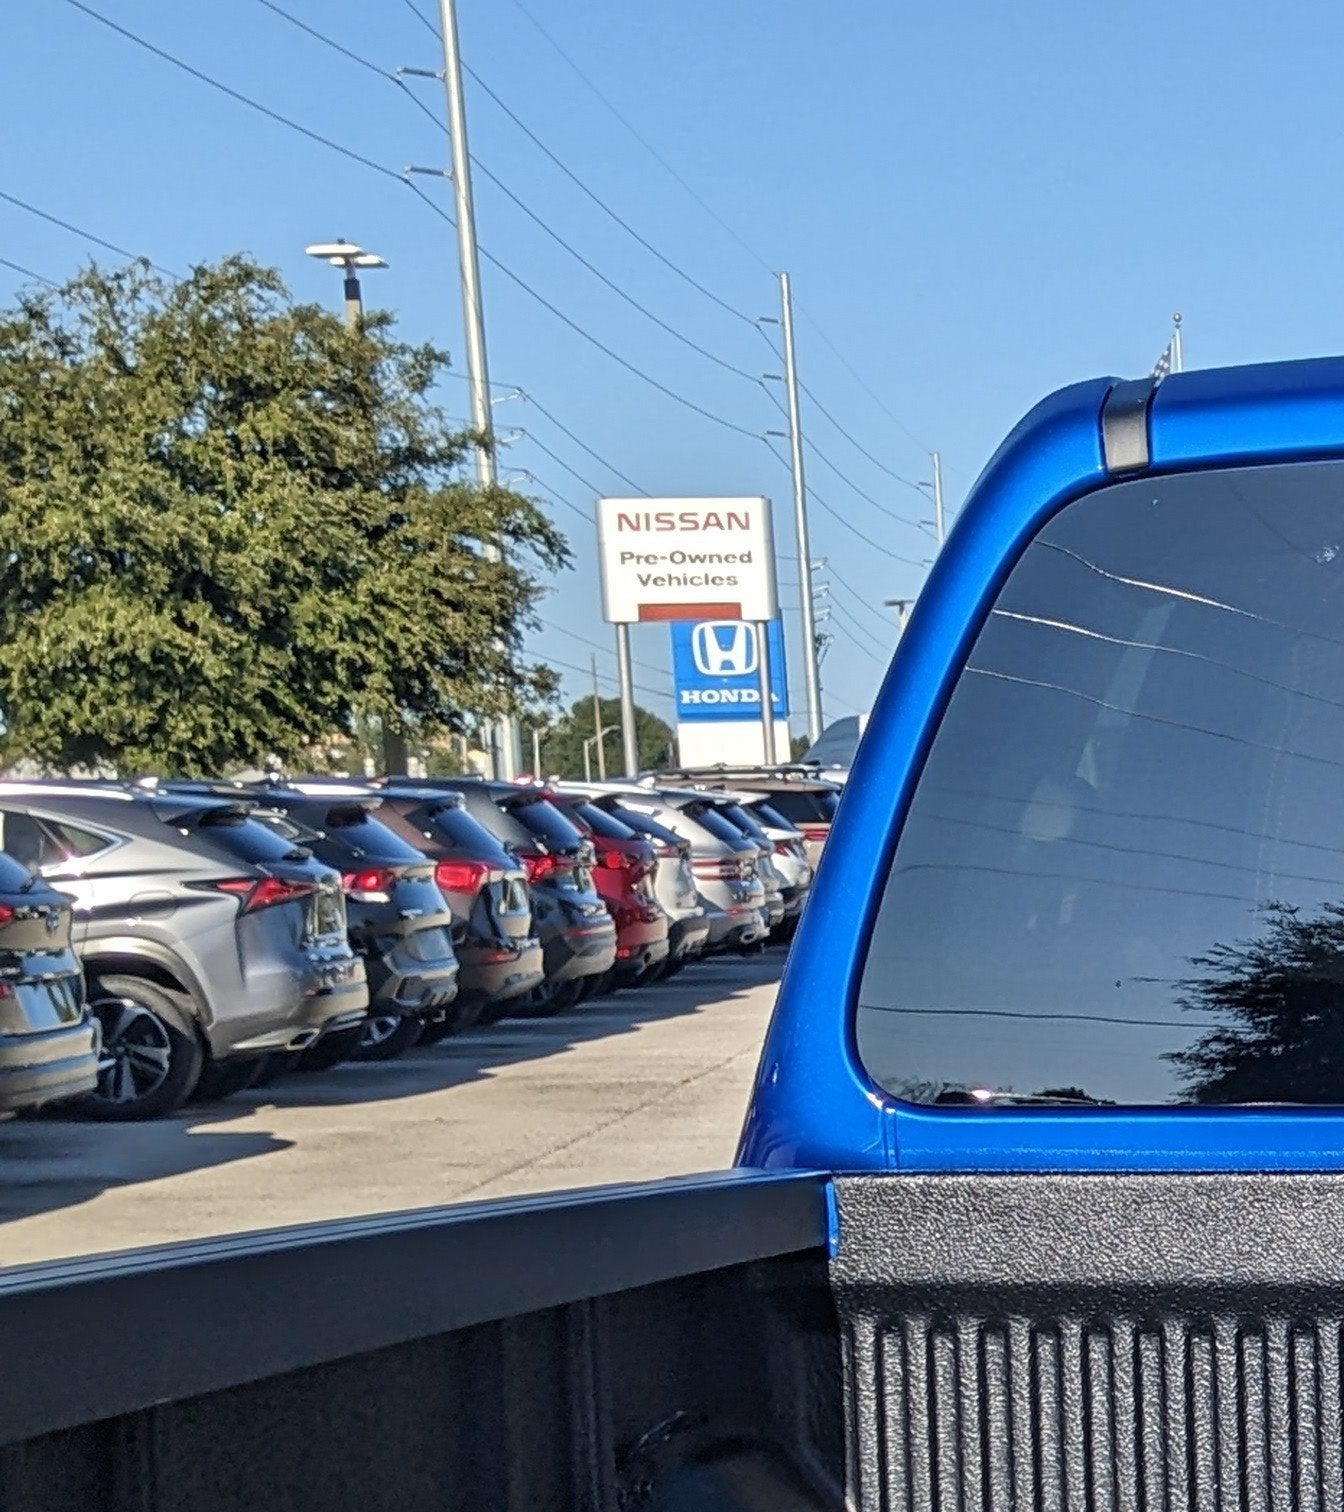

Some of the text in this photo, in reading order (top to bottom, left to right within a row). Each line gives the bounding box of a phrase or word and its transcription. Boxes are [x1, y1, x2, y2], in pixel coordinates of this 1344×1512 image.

[617, 511, 750, 531] NISSAN
[620, 550, 752, 565] Pre-Owned
[636, 572, 738, 586] Vehicles
